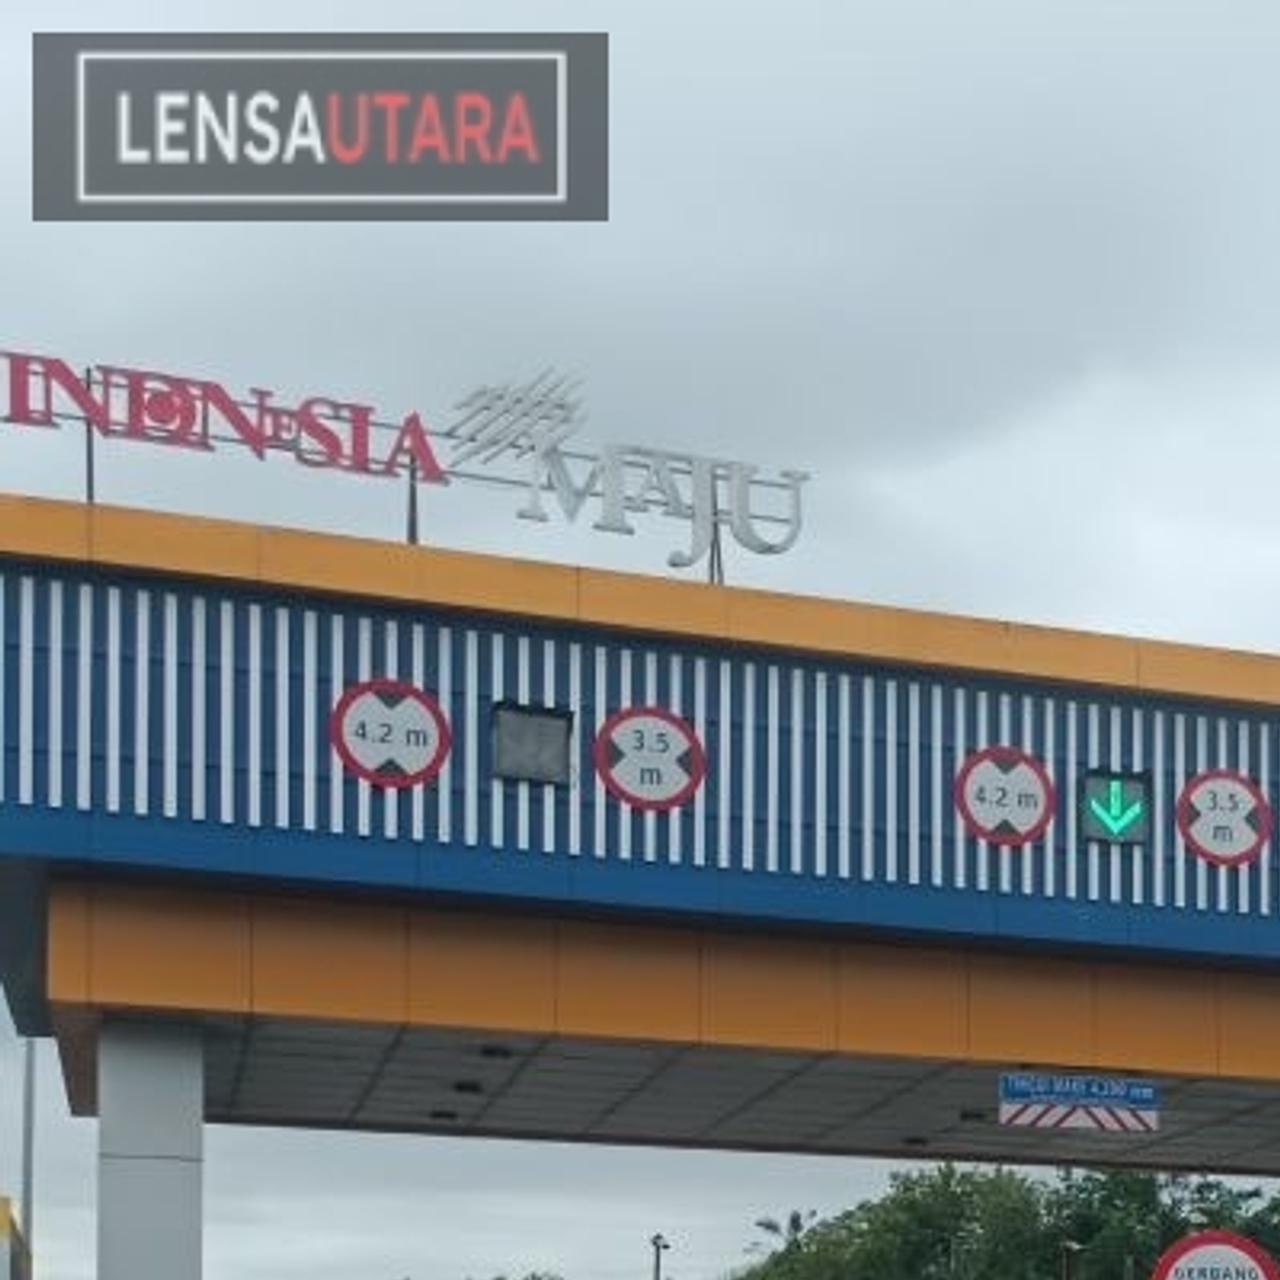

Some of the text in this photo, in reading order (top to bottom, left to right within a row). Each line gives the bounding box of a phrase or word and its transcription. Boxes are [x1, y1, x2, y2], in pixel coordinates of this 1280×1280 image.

[517, 444, 810, 567] MAJU
[354, 723, 428, 747] 4.2 m
[633, 729, 671, 754] 3.5
[640, 766, 663, 785] m
[975, 786, 1008, 807] 4.2
[1207, 791, 1240, 812] 3.5
[1212, 825, 1233, 842] m
